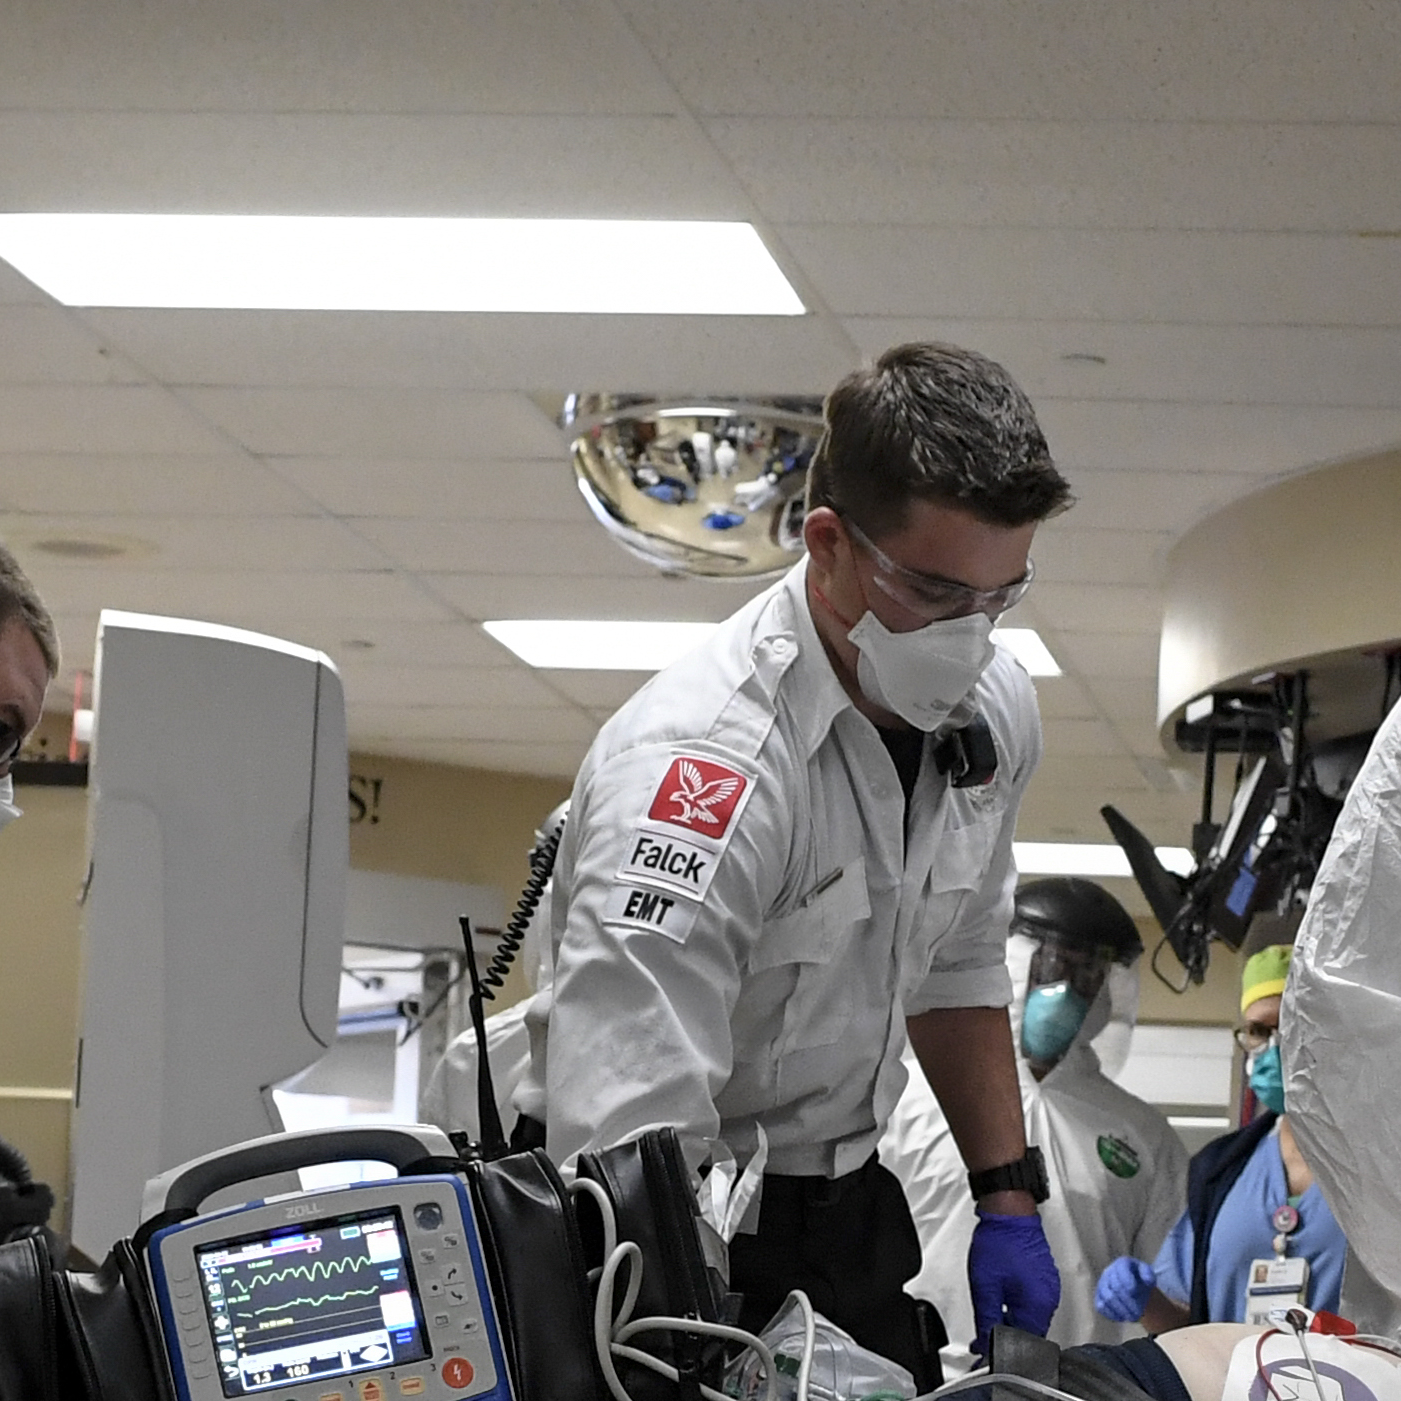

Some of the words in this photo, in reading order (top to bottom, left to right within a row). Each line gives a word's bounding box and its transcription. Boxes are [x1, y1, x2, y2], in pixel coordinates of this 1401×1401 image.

[630, 837, 706, 884] Falck
[623, 890, 674, 925] EMT
[285, 1203, 323, 1219] ZOLL
